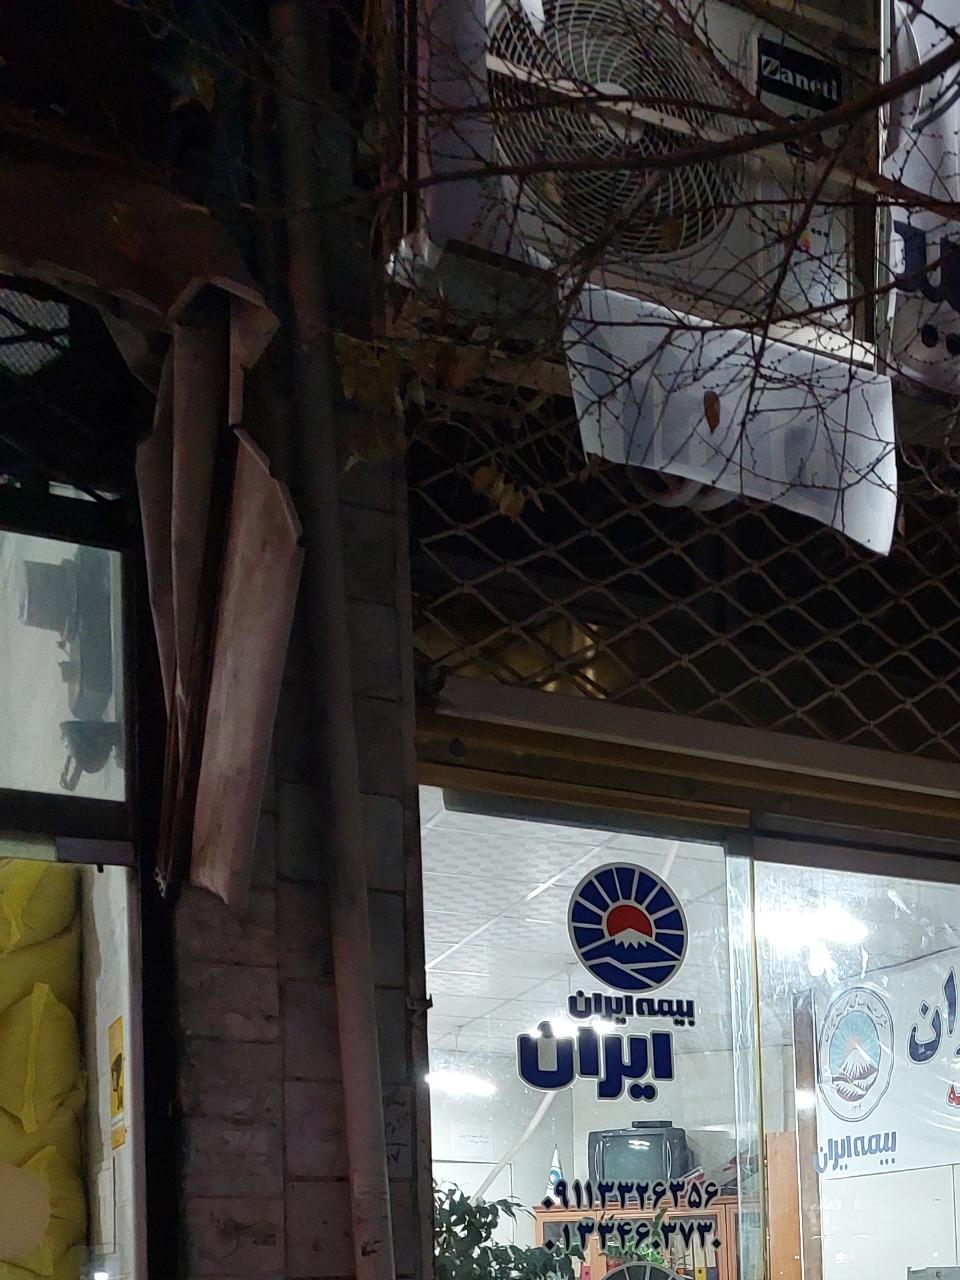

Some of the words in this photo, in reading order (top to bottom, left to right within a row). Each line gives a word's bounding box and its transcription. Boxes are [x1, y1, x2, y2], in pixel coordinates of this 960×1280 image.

[516, 1020, 675, 1102] ایران
[541, 1178, 720, 1211] ۰۹۱۱۳۳۲۶۳۵۶
[543, 1220, 722, 1252] ۰۱۳۳۴۶۰۳۷۳۰
